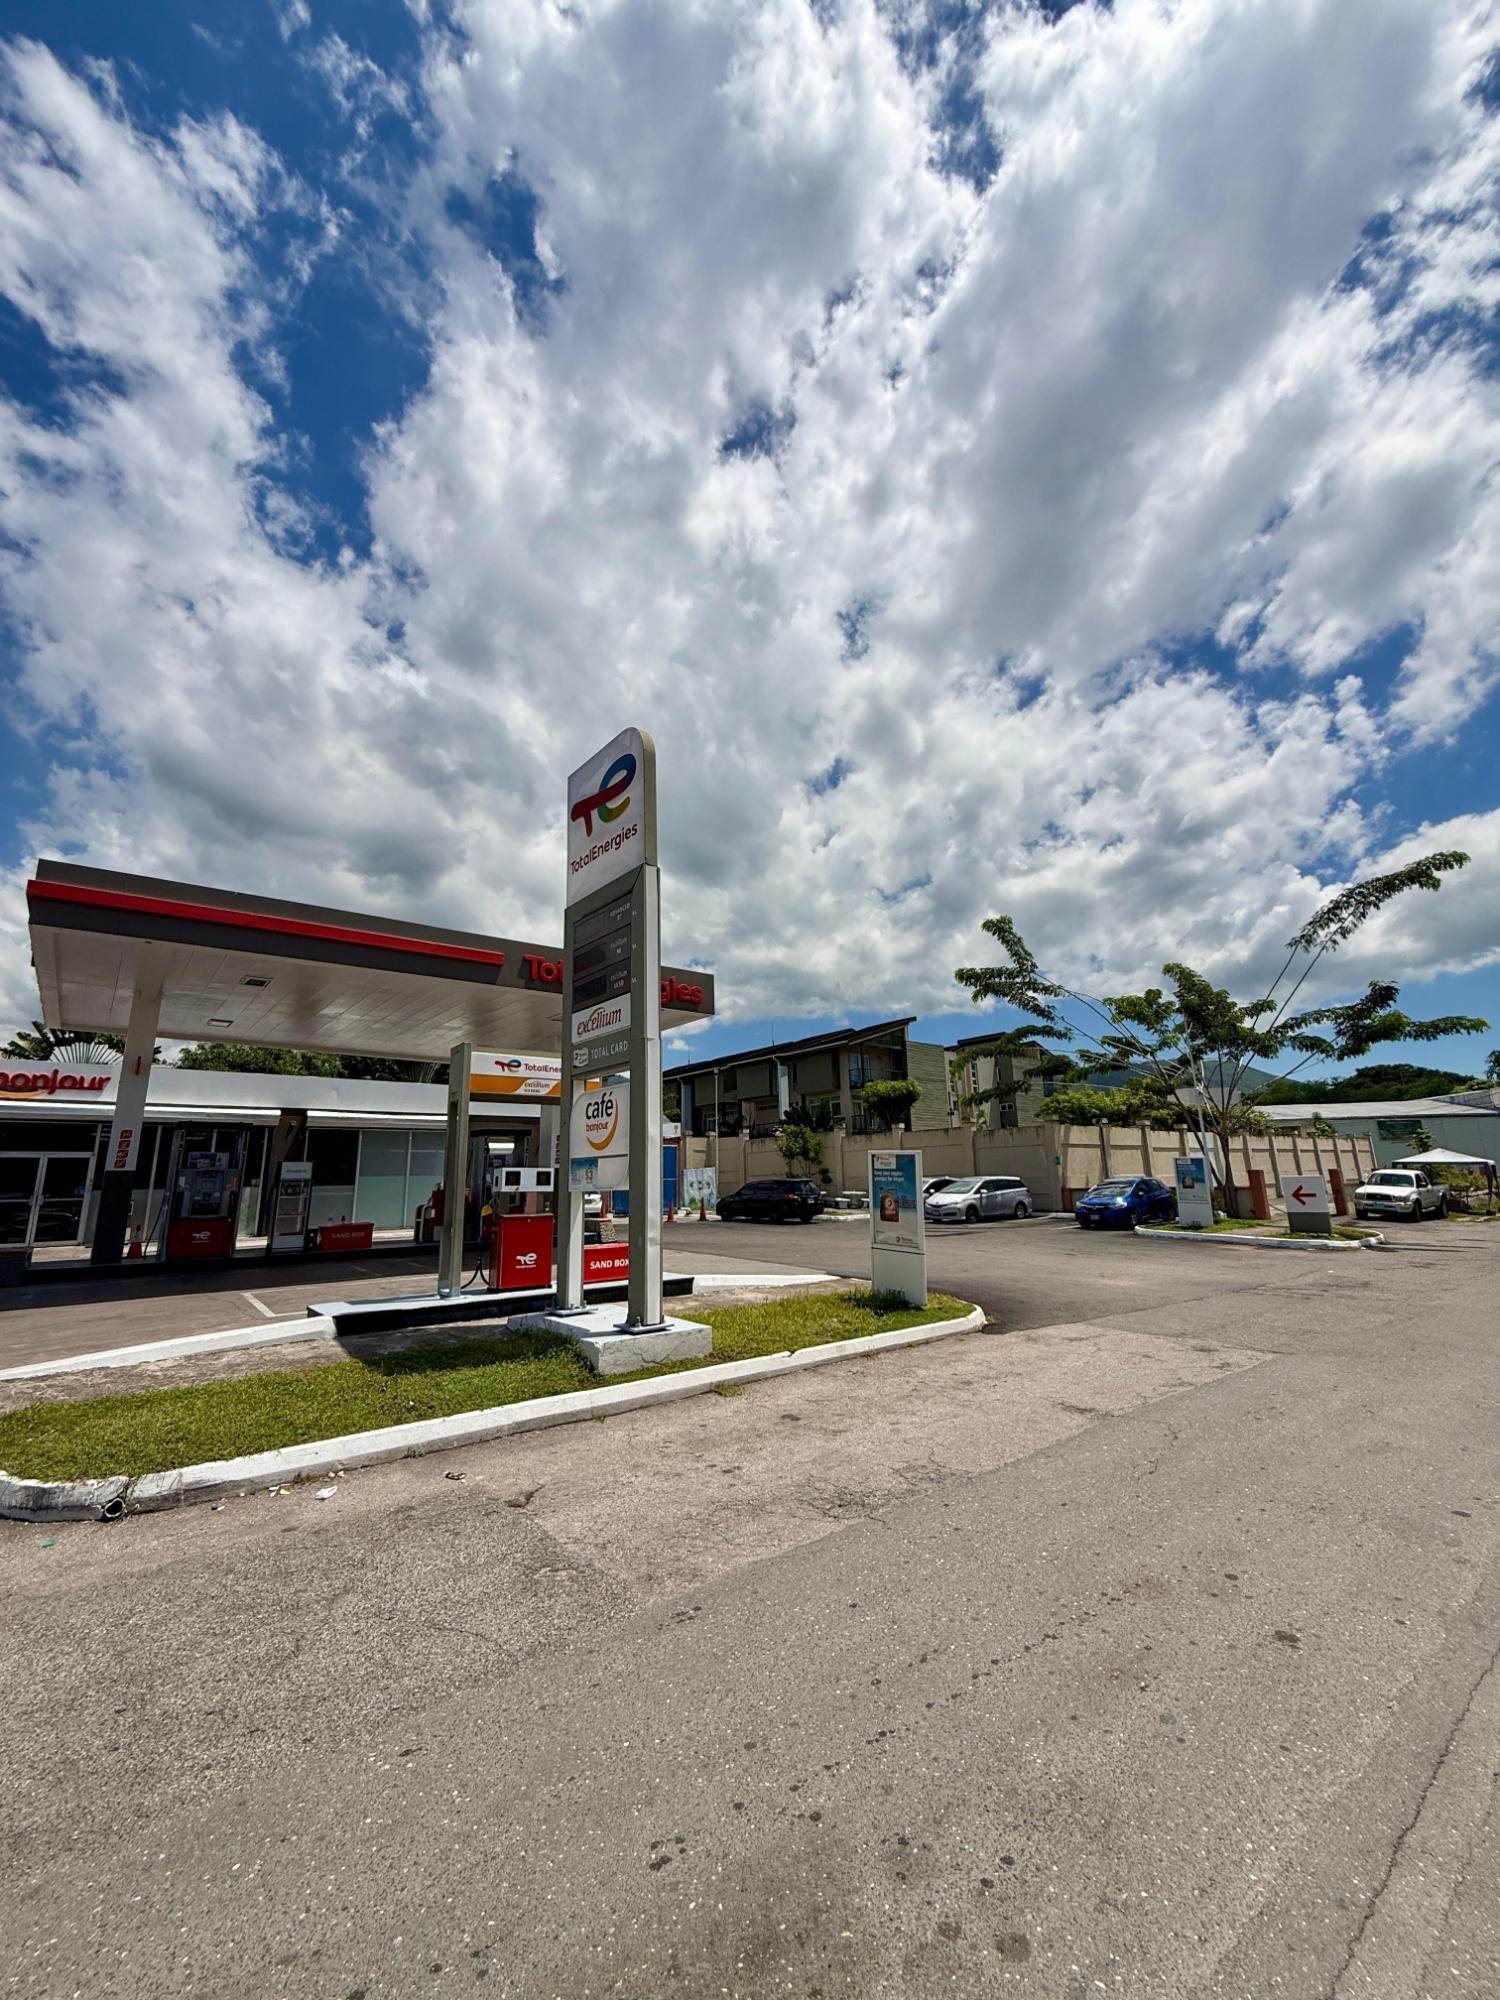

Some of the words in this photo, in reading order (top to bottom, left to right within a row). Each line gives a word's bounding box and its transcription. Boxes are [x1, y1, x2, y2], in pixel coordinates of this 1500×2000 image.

[570, 823, 638, 875] TotalEnergies
[576, 1007, 622, 1036] excellium
[591, 1046, 610, 1060] TOTAL
[610, 1040, 629, 1055] CARD
[585, 1091, 614, 1120] café
[585, 1120, 609, 1134] bonjour
[590, 1260, 612, 1270] SAND
[614, 1258, 629, 1267] BOX
